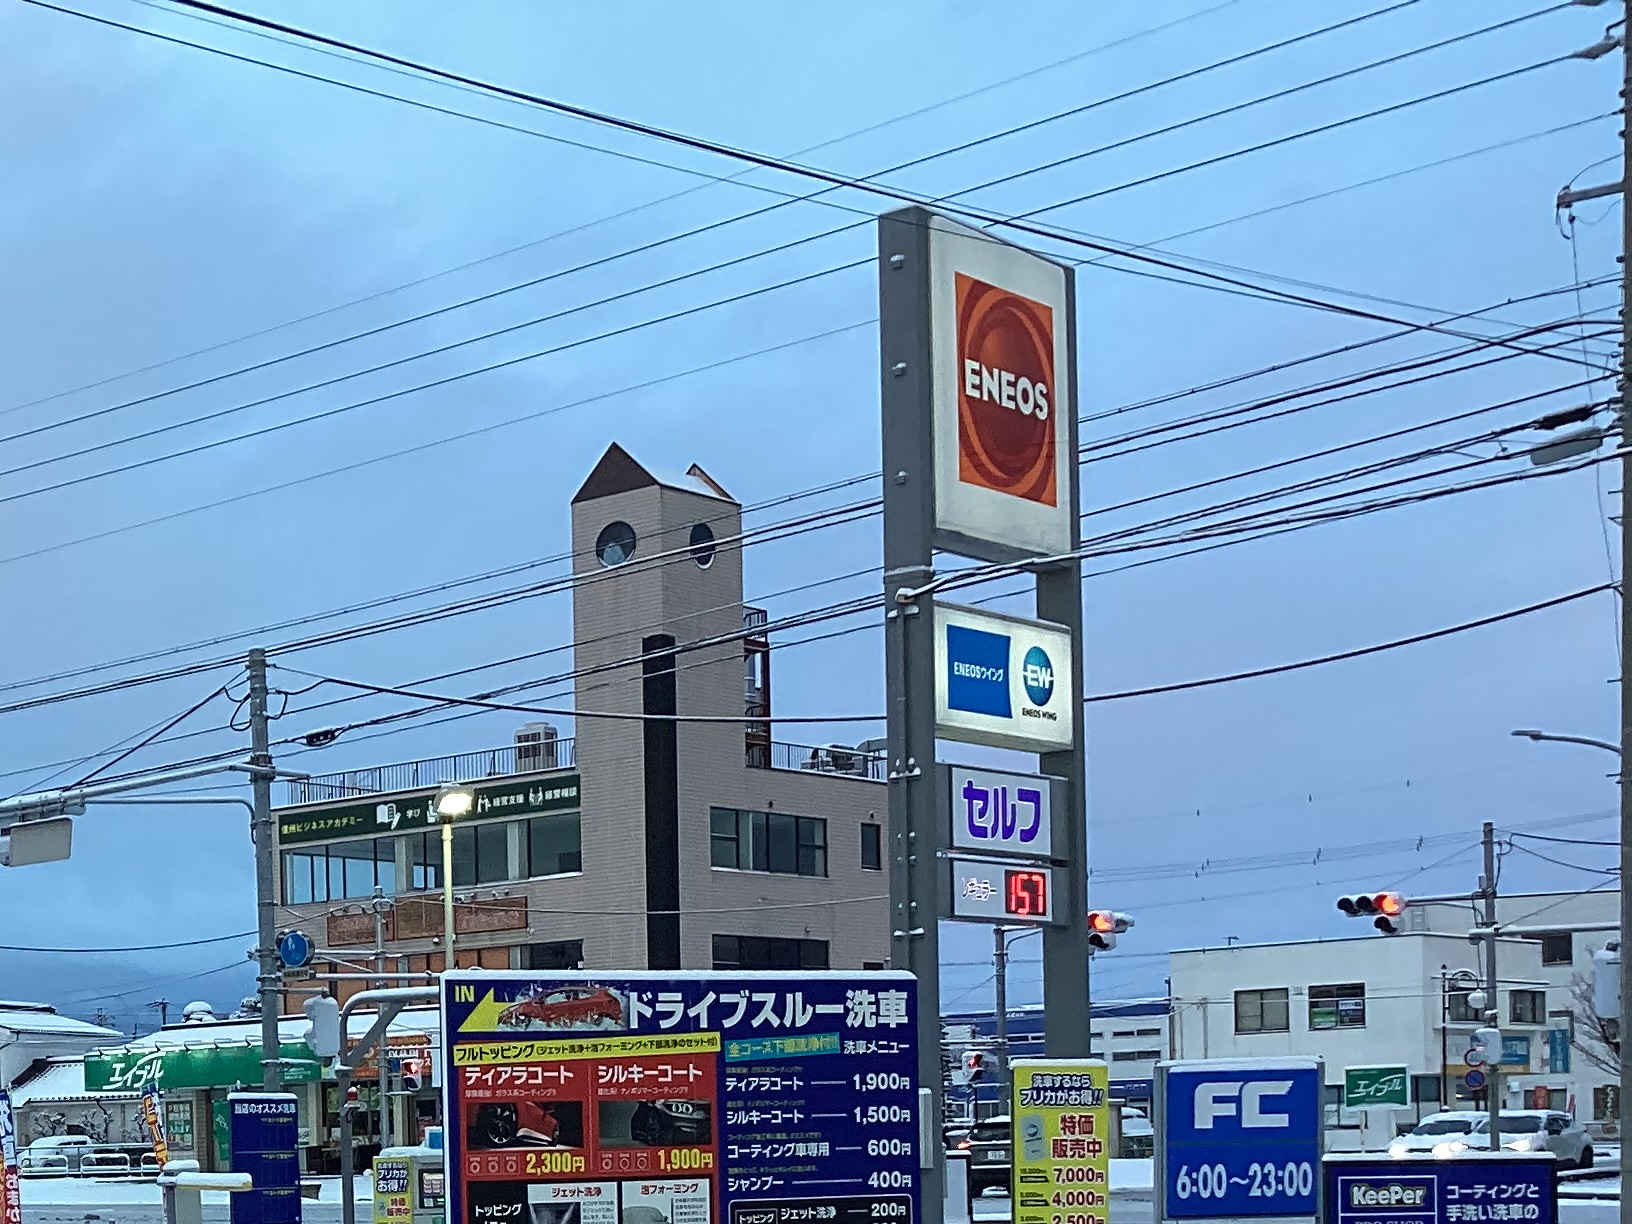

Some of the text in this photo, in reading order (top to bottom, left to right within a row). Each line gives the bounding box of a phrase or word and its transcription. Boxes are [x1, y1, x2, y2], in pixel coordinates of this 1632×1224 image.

[964, 358, 1048, 420] ENEOS
[1027, 663, 1050, 689] EW
[962, 779, 1041, 843] セルフ
[1010, 873, 1044, 914] 157
[455, 985, 474, 1003] IN
[629, 989, 908, 1029] ドライブスルー洗車
[456, 1044, 535, 1062] フルトッピング
[843, 1040, 910, 1055] 洗車メニュー
[103, 1051, 167, 1090] エイブル
[465, 1065, 574, 1086] ティアラコート
[597, 1063, 703, 1083] シルキーコート
[725, 1076, 804, 1091] ティアラコート
[853, 1073, 911, 1092] 1,900円
[1032, 1075, 1091, 1087] 洗車するなら
[1348, 1074, 1405, 1097] エイブル
[1020, 1089, 1104, 1106] プリカがお得!!
[1194, 1080, 1294, 1129] FC
[726, 1108, 804, 1125] シルキーコート
[854, 1106, 911, 1125] 1,500円
[1060, 1114, 1094, 1136] 特価
[727, 1142, 830, 1158] コーティング車専用
[867, 1139, 911, 1156] 600円
[1052, 1138, 1102, 1159] 販売中
[526, 1152, 585, 1176] 2,300円
[658, 1149, 713, 1172] 1,900円
[728, 1175, 785, 1191] シャンプー
[867, 1171, 912, 1188] 400円
[1053, 1167, 1104, 1184] 7,000円
[1052, 1191, 1104, 1208] 4,000円
[1352, 1184, 1425, 1206] KeePer
[1447, 1184, 1539, 1199] コーティングと
[475, 1203, 522, 1217] トッピング
[739, 1213, 774, 1224] トッピング
[780, 1206, 836, 1220] ジェット洗浄
[871, 1203, 906, 1216] 200円
[1446, 1204, 1539, 1221] 手洗い洗車の
